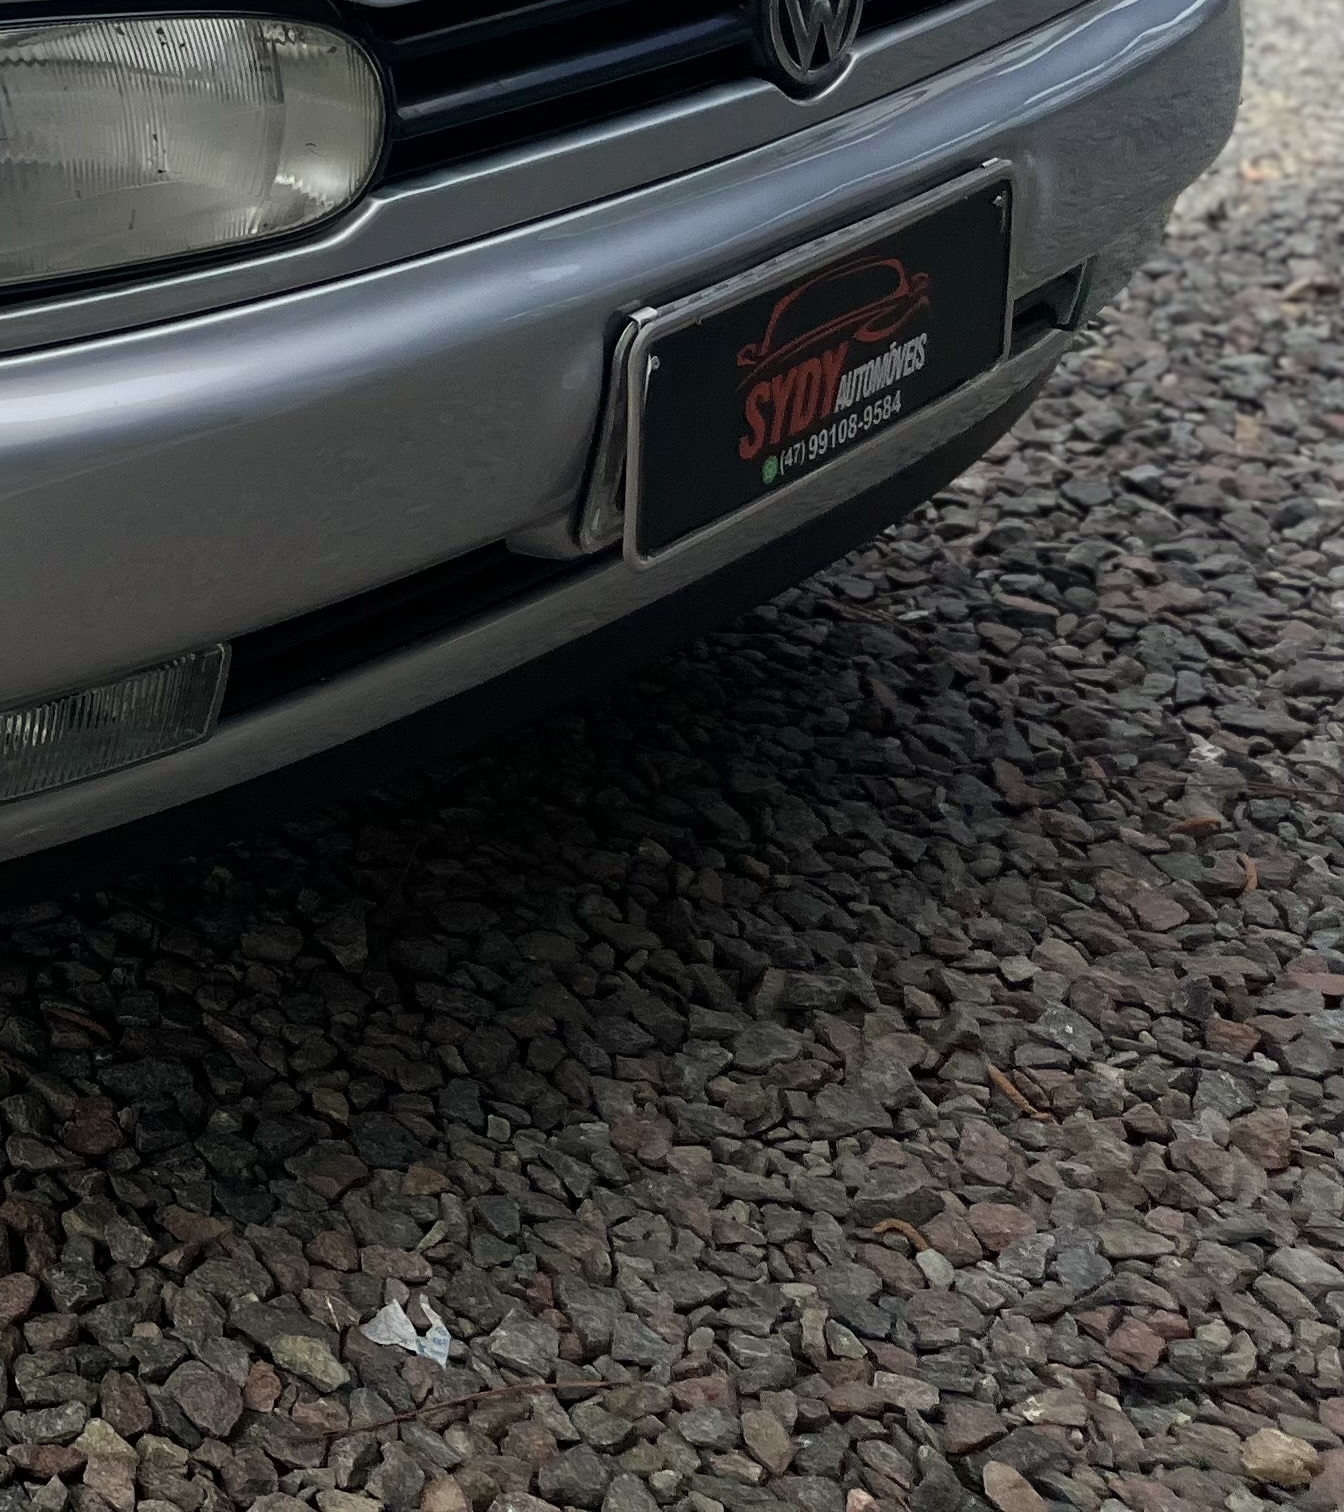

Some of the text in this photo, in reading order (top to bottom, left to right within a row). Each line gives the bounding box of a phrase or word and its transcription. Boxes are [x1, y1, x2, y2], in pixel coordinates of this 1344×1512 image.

[739, 333, 927, 460] SYDY AUTOMÓVEIS
[780, 390, 901, 476] (47) 99108-9584
